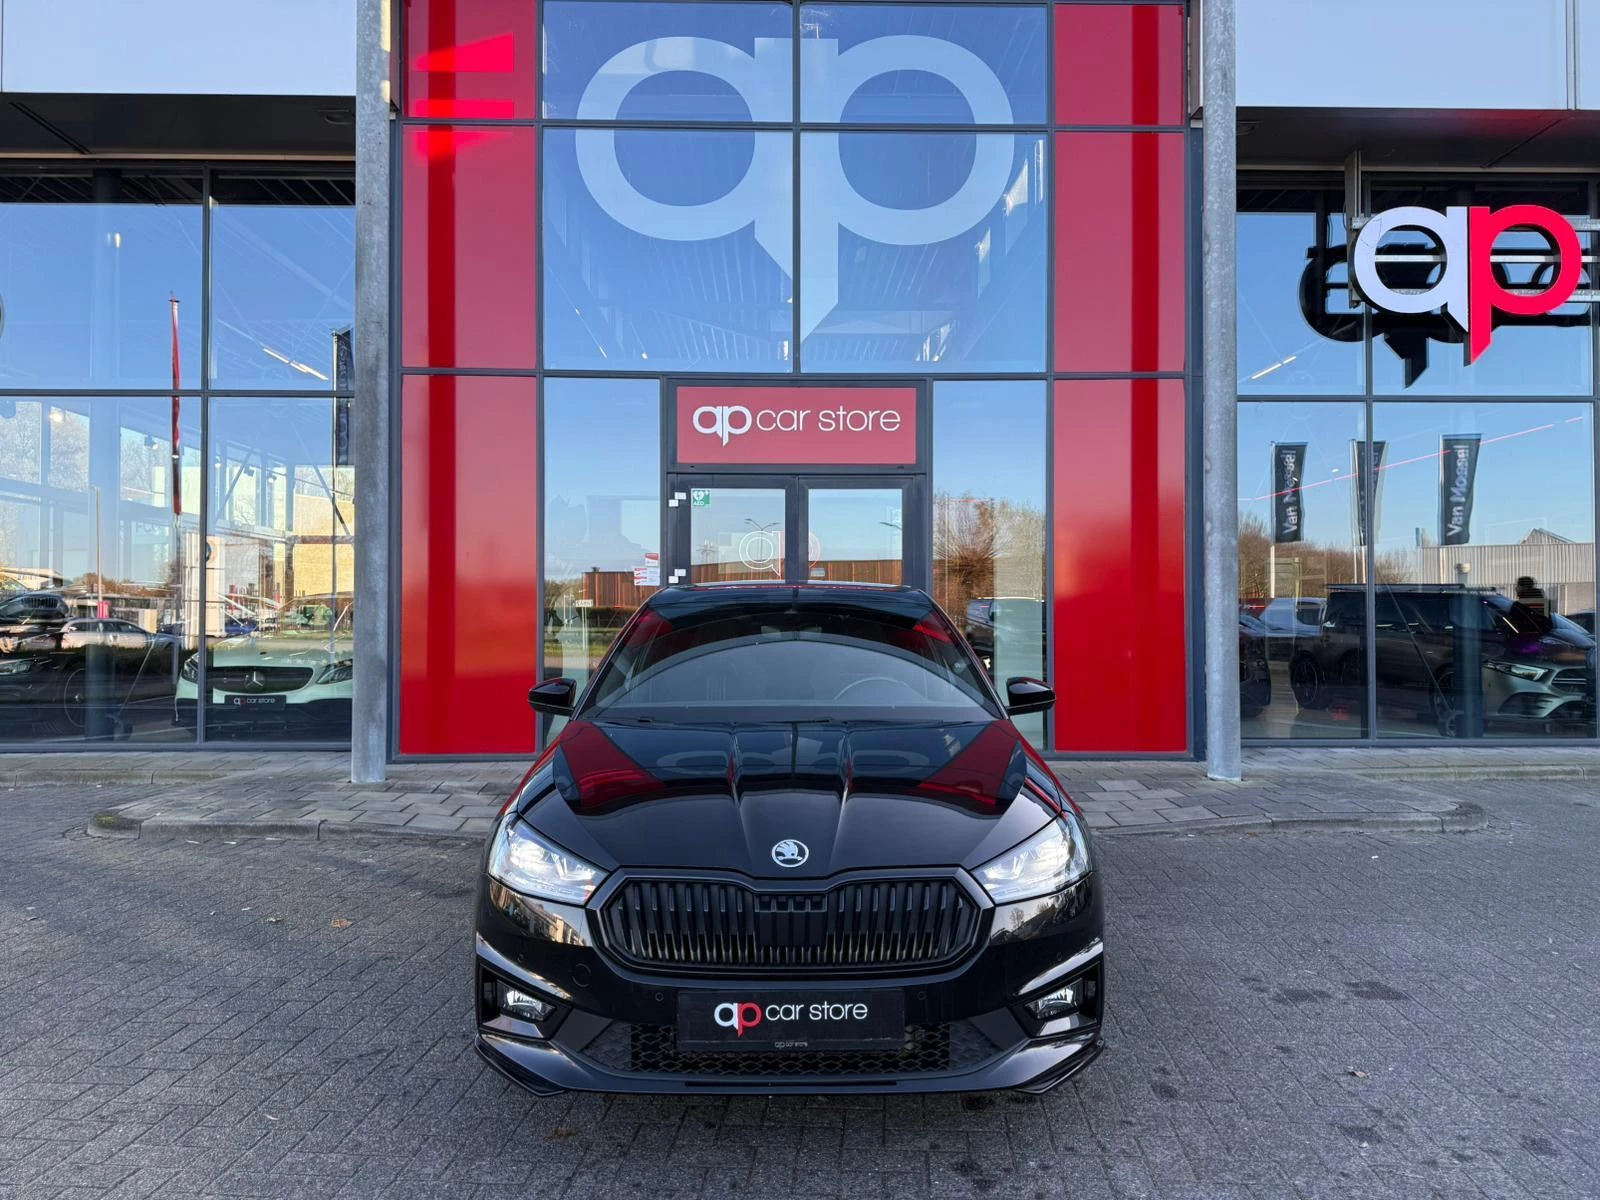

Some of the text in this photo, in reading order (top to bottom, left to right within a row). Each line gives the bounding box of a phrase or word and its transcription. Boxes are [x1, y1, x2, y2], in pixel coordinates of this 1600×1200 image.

[1353, 204, 1582, 365] ap
[692, 405, 901, 447] ap car store
[1282, 505, 1298, 535] Van
[1446, 505, 1465, 536] Van
[714, 1000, 869, 1037] ap car store
